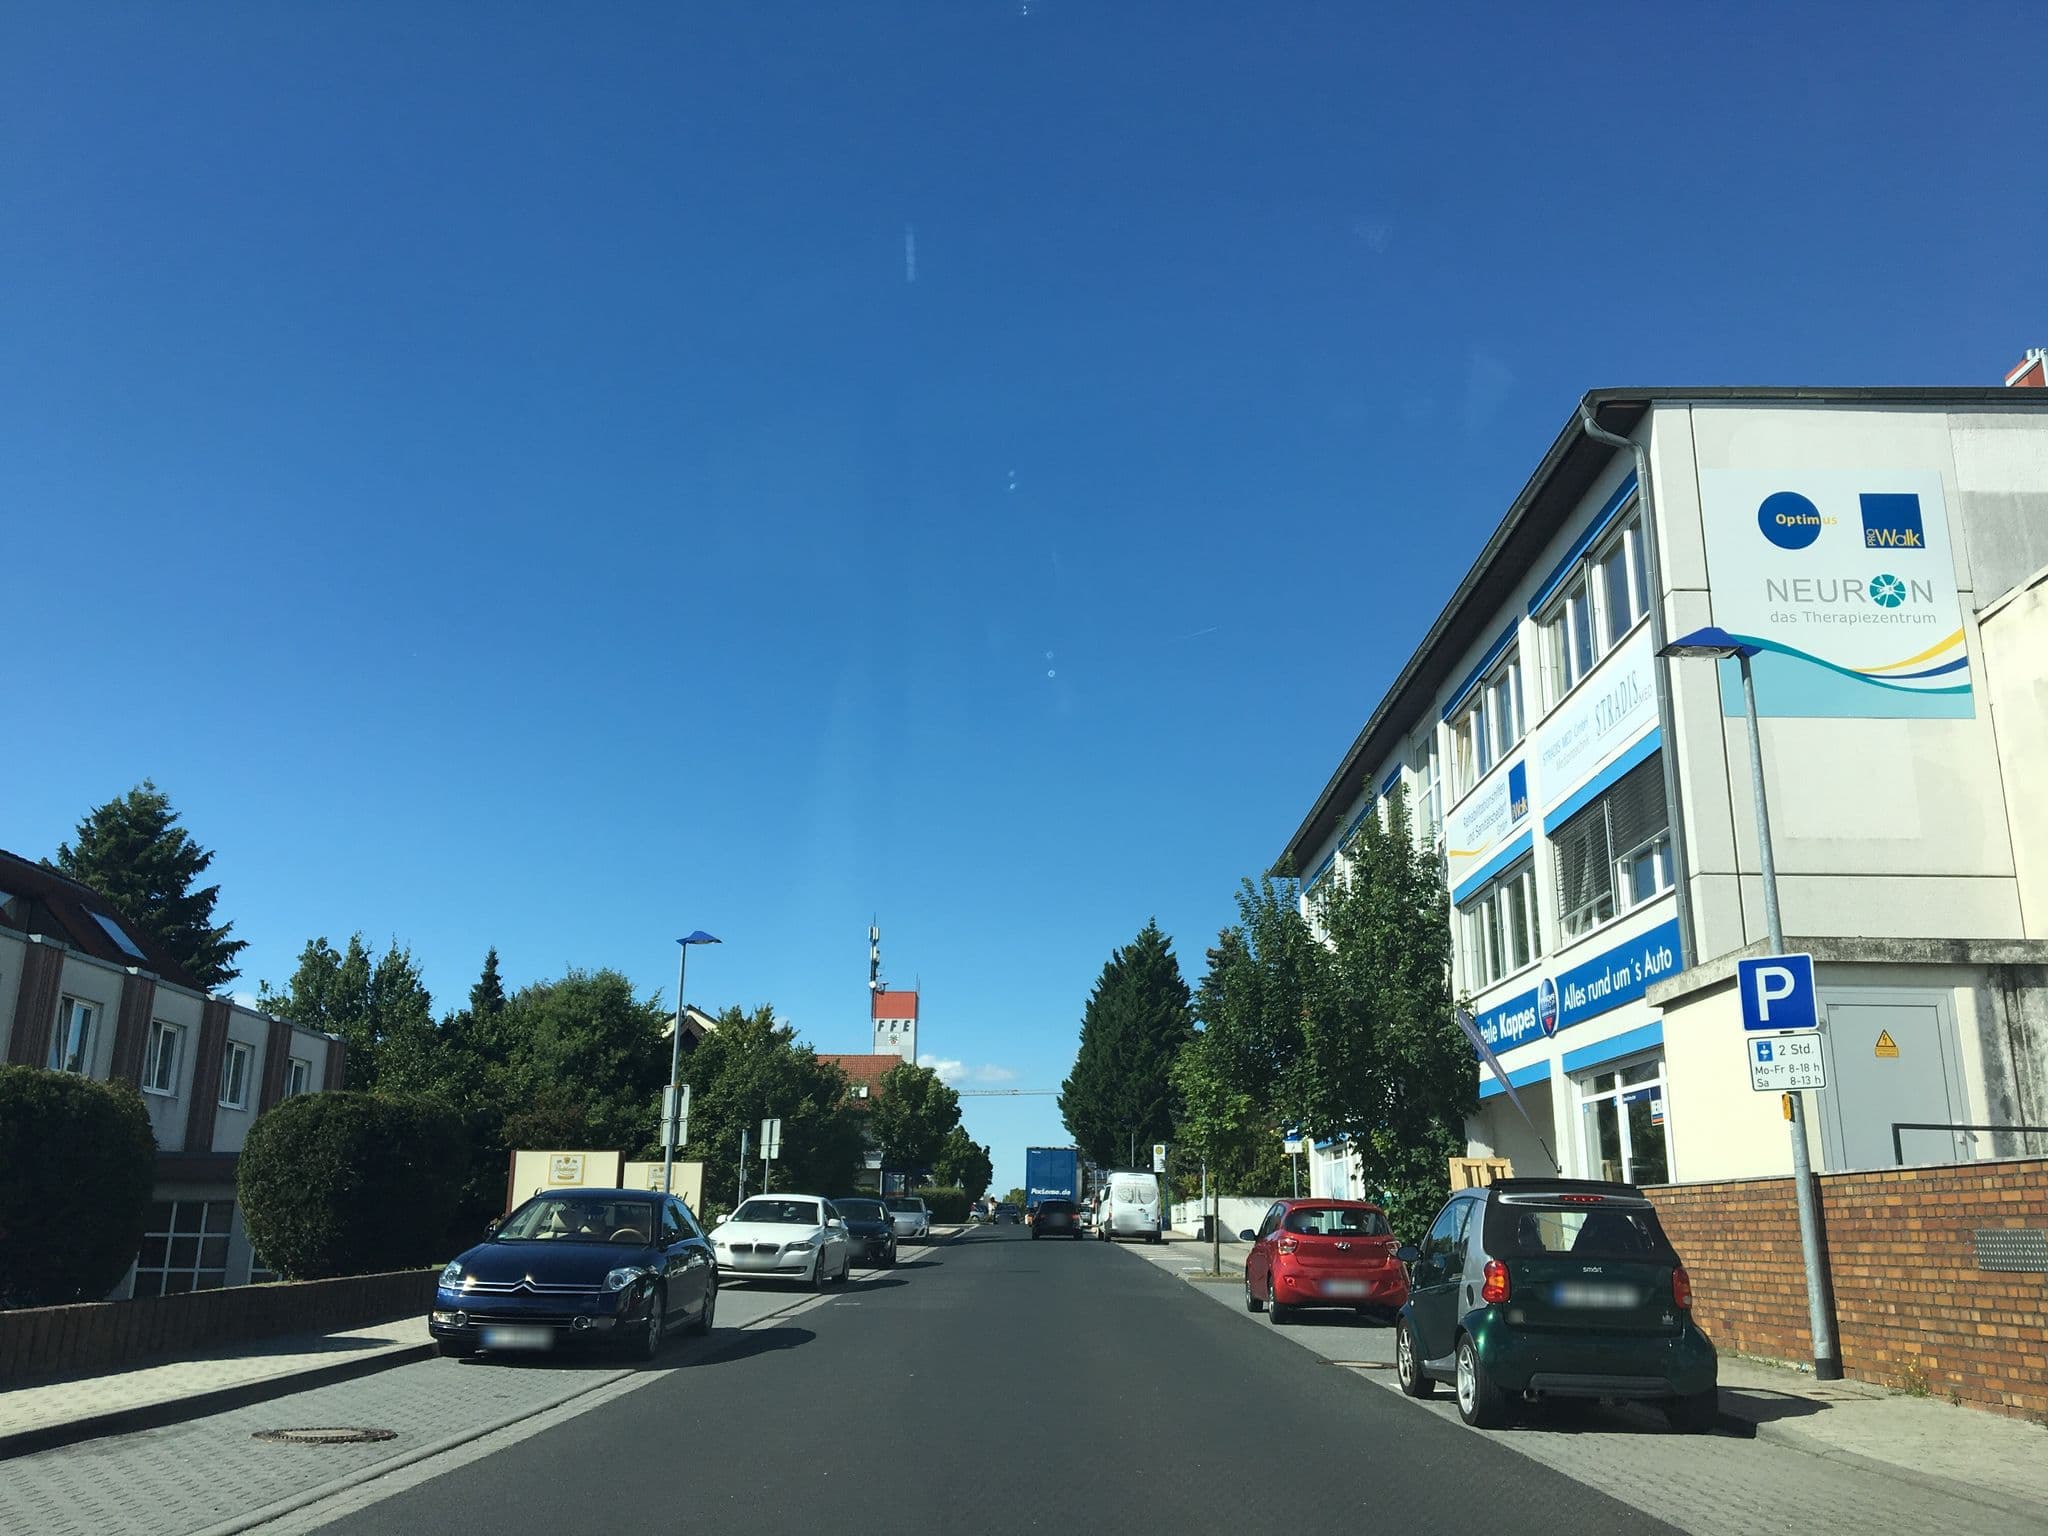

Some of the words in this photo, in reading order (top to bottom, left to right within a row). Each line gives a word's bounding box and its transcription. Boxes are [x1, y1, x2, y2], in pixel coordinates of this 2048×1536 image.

[1775, 513, 1838, 527] Optimus
[1866, 528, 1875, 547] PRO
[1875, 528, 1922, 547] Walk
[1766, 574, 1934, 608] NEURON
[1770, 610, 1797, 624] das
[1802, 610, 1937, 626] Therapiezentrum
[1595, 670, 1639, 737] STRADIS
[1563, 985, 1587, 1012] Alles
[1588, 966, 1612, 1000] rund
[1645, 945, 1673, 978] Auto
[1755, 966, 1796, 1022] P
[1498, 1007, 1536, 1042] Kappes
[1779, 1045, 1786, 1056] 2
[1755, 1064, 1785, 1075] Mo-Fr
[1788, 1063, 1810, 1073] 8-18
[1813, 1062, 1820, 1072] h
[1757, 1078, 1770, 1088] Sa
[1790, 1075, 1811, 1086] 8-13
[1814, 1075, 1821, 1085] h
